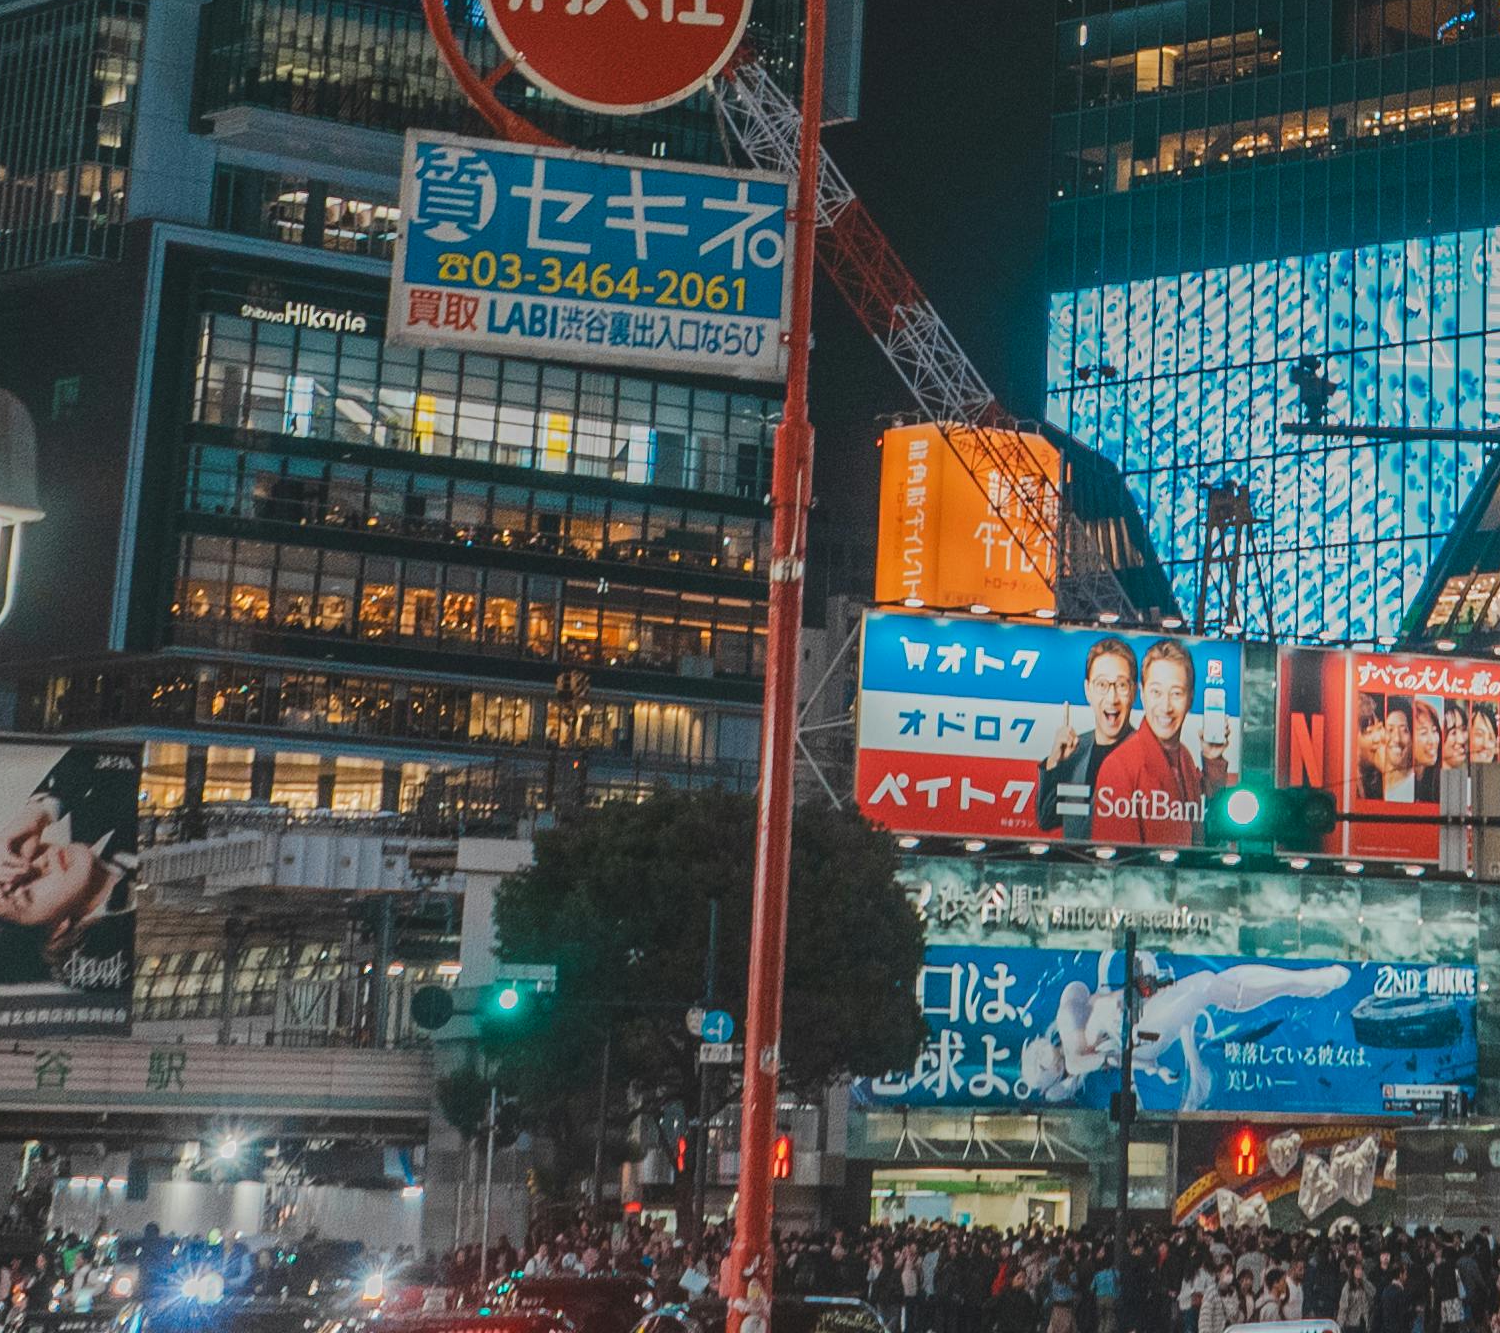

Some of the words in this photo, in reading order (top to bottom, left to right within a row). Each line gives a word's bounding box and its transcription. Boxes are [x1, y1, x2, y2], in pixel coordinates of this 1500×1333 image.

[413, 145, 498, 242] 質
[470, 253, 748, 312] 03-3464-2061
[285, 300, 368, 333] Hikarie
[405, 288, 479, 332] 買取
[902, 438, 930, 598] 龍角散ダイレクト
[936, 642, 1041, 679] オトク
[898, 708, 1036, 744] オドロク
[867, 771, 1036, 814] ペイトク
[938, 882, 1046, 925] 渋谷駅
[1137, 904, 1213, 934] station
